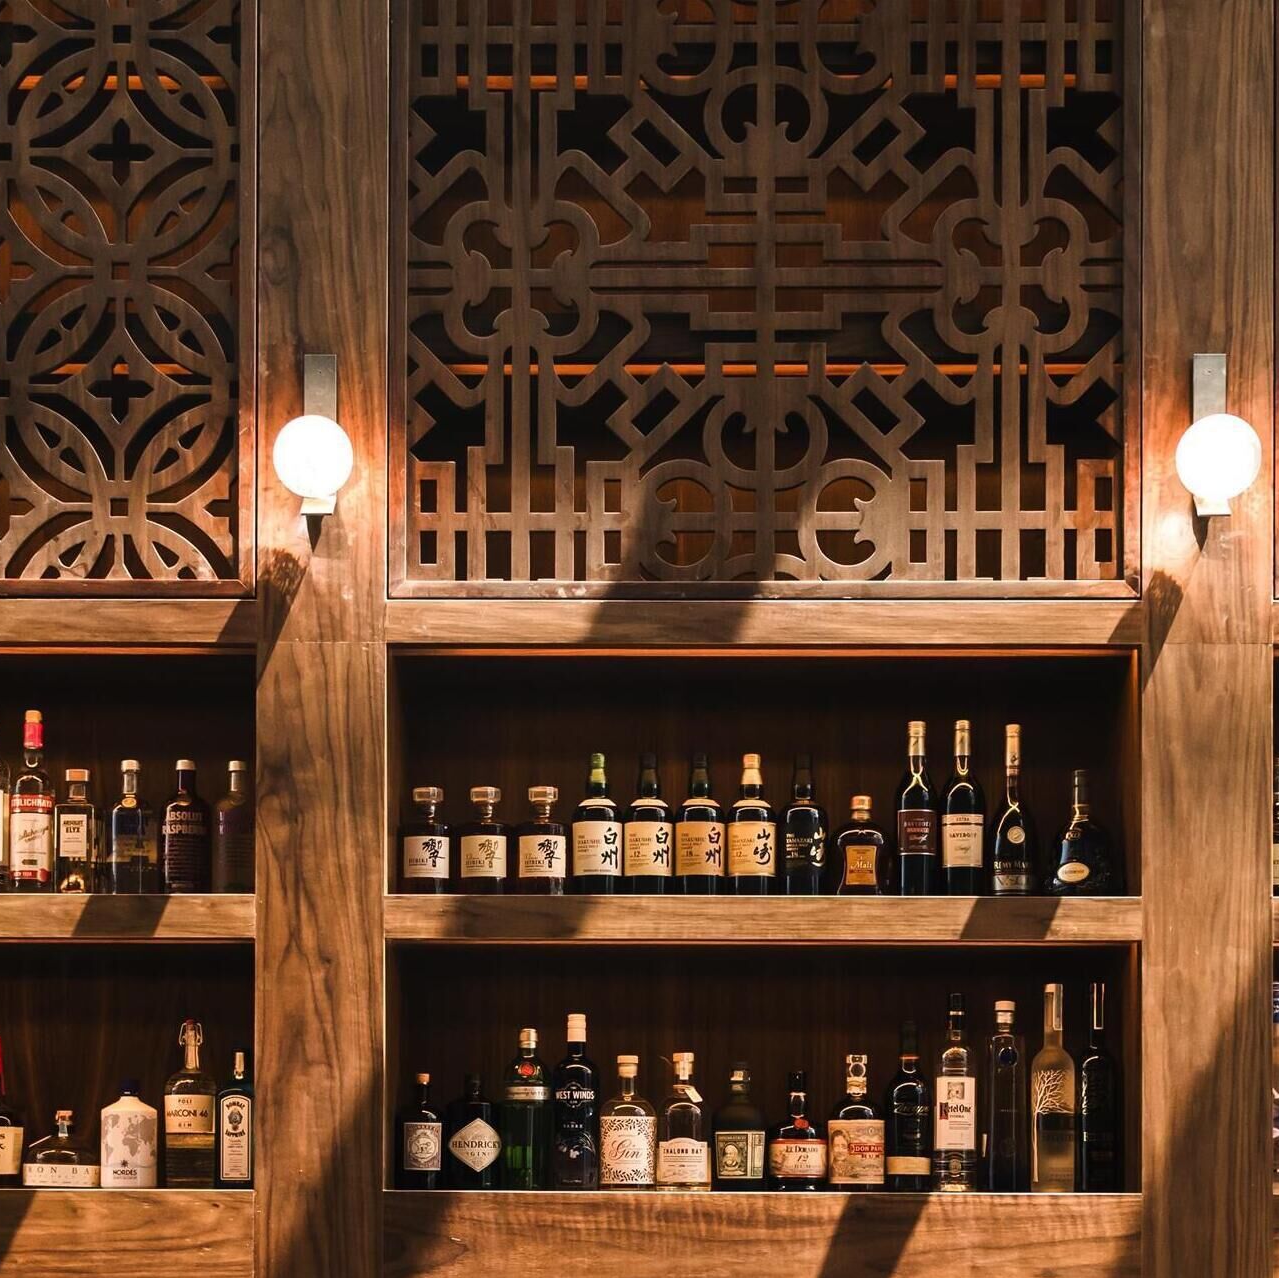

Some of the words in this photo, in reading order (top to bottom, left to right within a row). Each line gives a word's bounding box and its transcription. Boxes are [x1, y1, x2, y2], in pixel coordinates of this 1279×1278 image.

[601, 827, 618, 869] 白州
[653, 827, 670, 869] 白州
[705, 826, 722, 870] 白州
[572, 1089, 596, 1101] WINDS
[199, 1109, 208, 1117] 46
[959, 1104, 972, 1114] One
[608, 1139, 643, 1162] Gin
